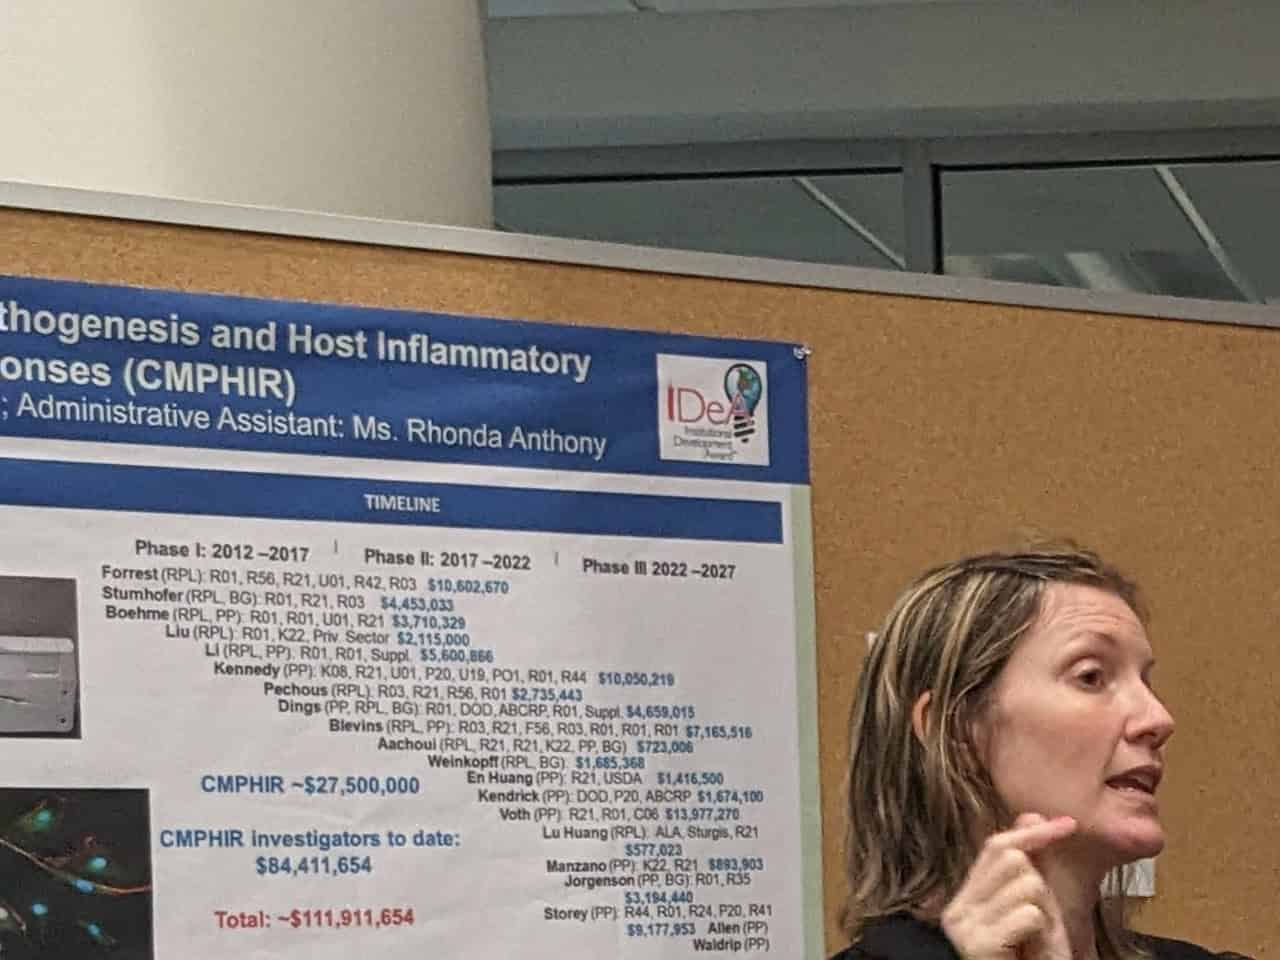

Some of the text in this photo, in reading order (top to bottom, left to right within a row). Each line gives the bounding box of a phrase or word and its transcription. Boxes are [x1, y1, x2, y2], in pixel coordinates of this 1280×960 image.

[0, 300, 592, 383] thogenesis and Host Inflammatory
[0, 356, 297, 407] onses (CMPHIR)
[667, 384, 755, 425] IDeA
[17, 392, 607, 461] Administrative Assistant: Ms. Rhonda Anthony
[674, 436, 733, 448] Development
[364, 493, 441, 513] TIMELINE
[135, 539, 189, 559] Phase
[196, 541, 207, 558] I:
[212, 543, 254, 561] 2012
[365, 549, 415, 567] Phase
[421, 551, 435, 567] II:
[440, 551, 478, 569] 2017
[583, 558, 627, 576] Phase
[635, 560, 647, 576] III
[652, 561, 688, 578] 2022
[102, 565, 158, 581] Forrest
[210, 569, 243, 586] R01,
[283, 571, 314, 588] R21,
[318, 573, 350, 590] U01,
[354, 575, 386, 592] R42,
[389, 576, 417, 592] R03
[427, 579, 510, 595] $10,602,670
[105, 605, 169, 622] Boehme
[250, 610, 281, 626] R01,
[287, 611, 318, 627] R01,
[322, 612, 353, 628] U01,
[357, 613, 385, 629] R21
[392, 614, 466, 630] $3,710,329
[165, 623, 190, 639] Liu
[242, 626, 273, 642] R01,
[278, 627, 308, 643] K22,
[345, 630, 389, 646] Sector
[397, 631, 470, 647] $2,115,000
[201, 775, 421, 797] CMPHIR ~$27,500,000
[500, 806, 531, 821] Voth
[569, 807, 599, 822] R21,
[601, 807, 630, 822] R01,
[665, 807, 740, 821] $13,977,270
[160, 829, 244, 848] CMPHIR
[388, 831, 406, 848] to
[413, 830, 461, 848] date:
[256, 856, 373, 877] $84,411,654
[214, 908, 415, 931] Total: ~$111,911,654
